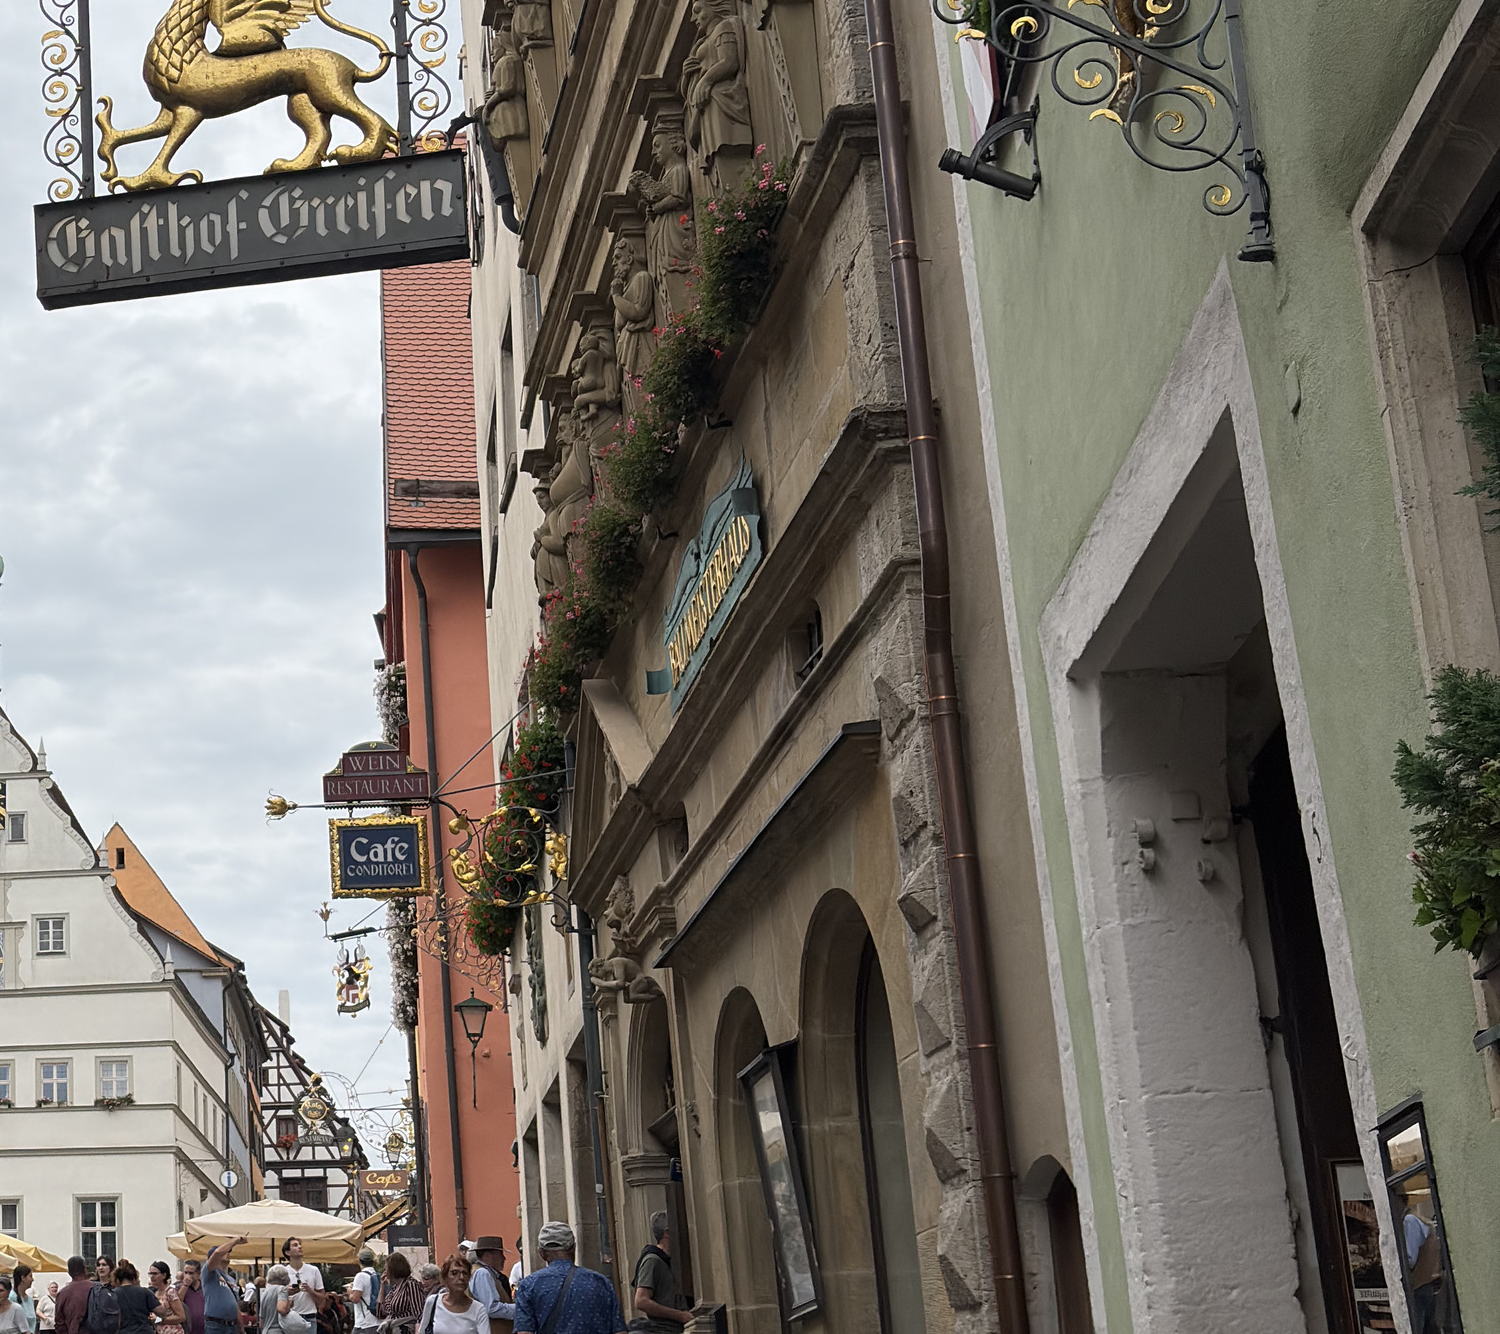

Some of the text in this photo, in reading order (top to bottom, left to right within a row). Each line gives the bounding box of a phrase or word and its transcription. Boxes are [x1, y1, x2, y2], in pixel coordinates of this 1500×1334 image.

[46, 168, 456, 274] Gasthof Greifen
[348, 755, 401, 772] WEIN
[327, 777, 426, 796] RESTAURANT
[350, 836, 410, 863] Cafe
[346, 862, 414, 877] CONDITOREI
